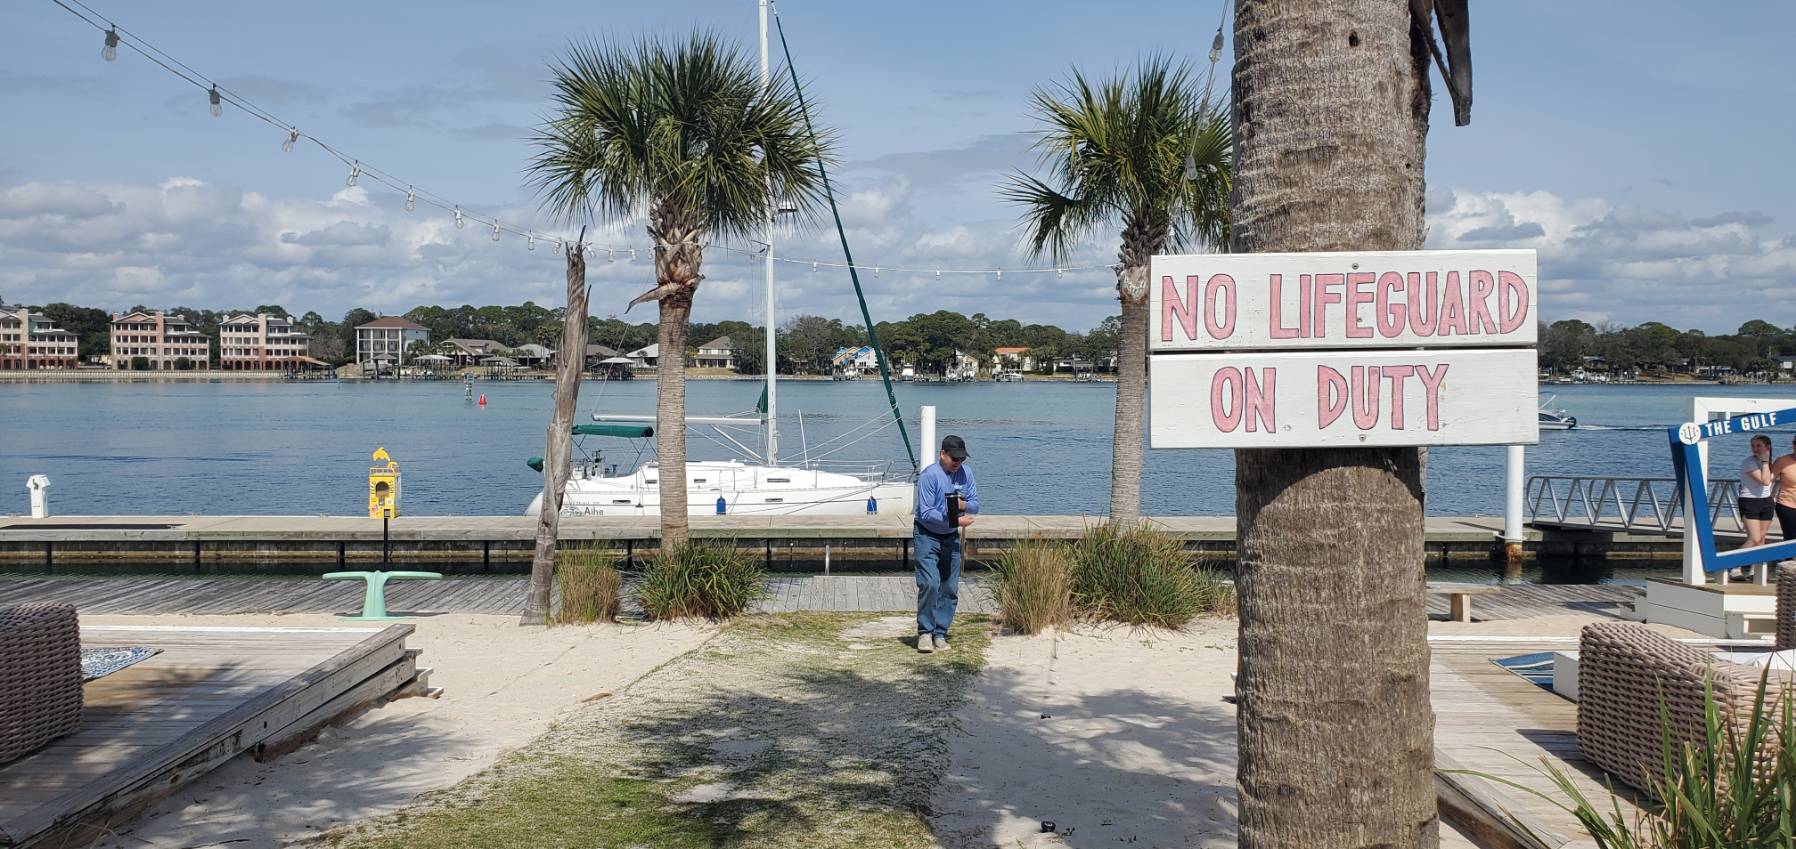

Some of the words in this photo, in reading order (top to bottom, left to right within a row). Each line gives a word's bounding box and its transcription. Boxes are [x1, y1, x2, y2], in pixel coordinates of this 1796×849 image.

[1161, 273, 1237, 341] NO
[1269, 270, 1529, 339] LIFEGUARD
[1210, 366, 1277, 433] ON
[1317, 363, 1450, 431] DUTY
[1705, 420, 1732, 437] THE
[1741, 412, 1777, 431] GULF
